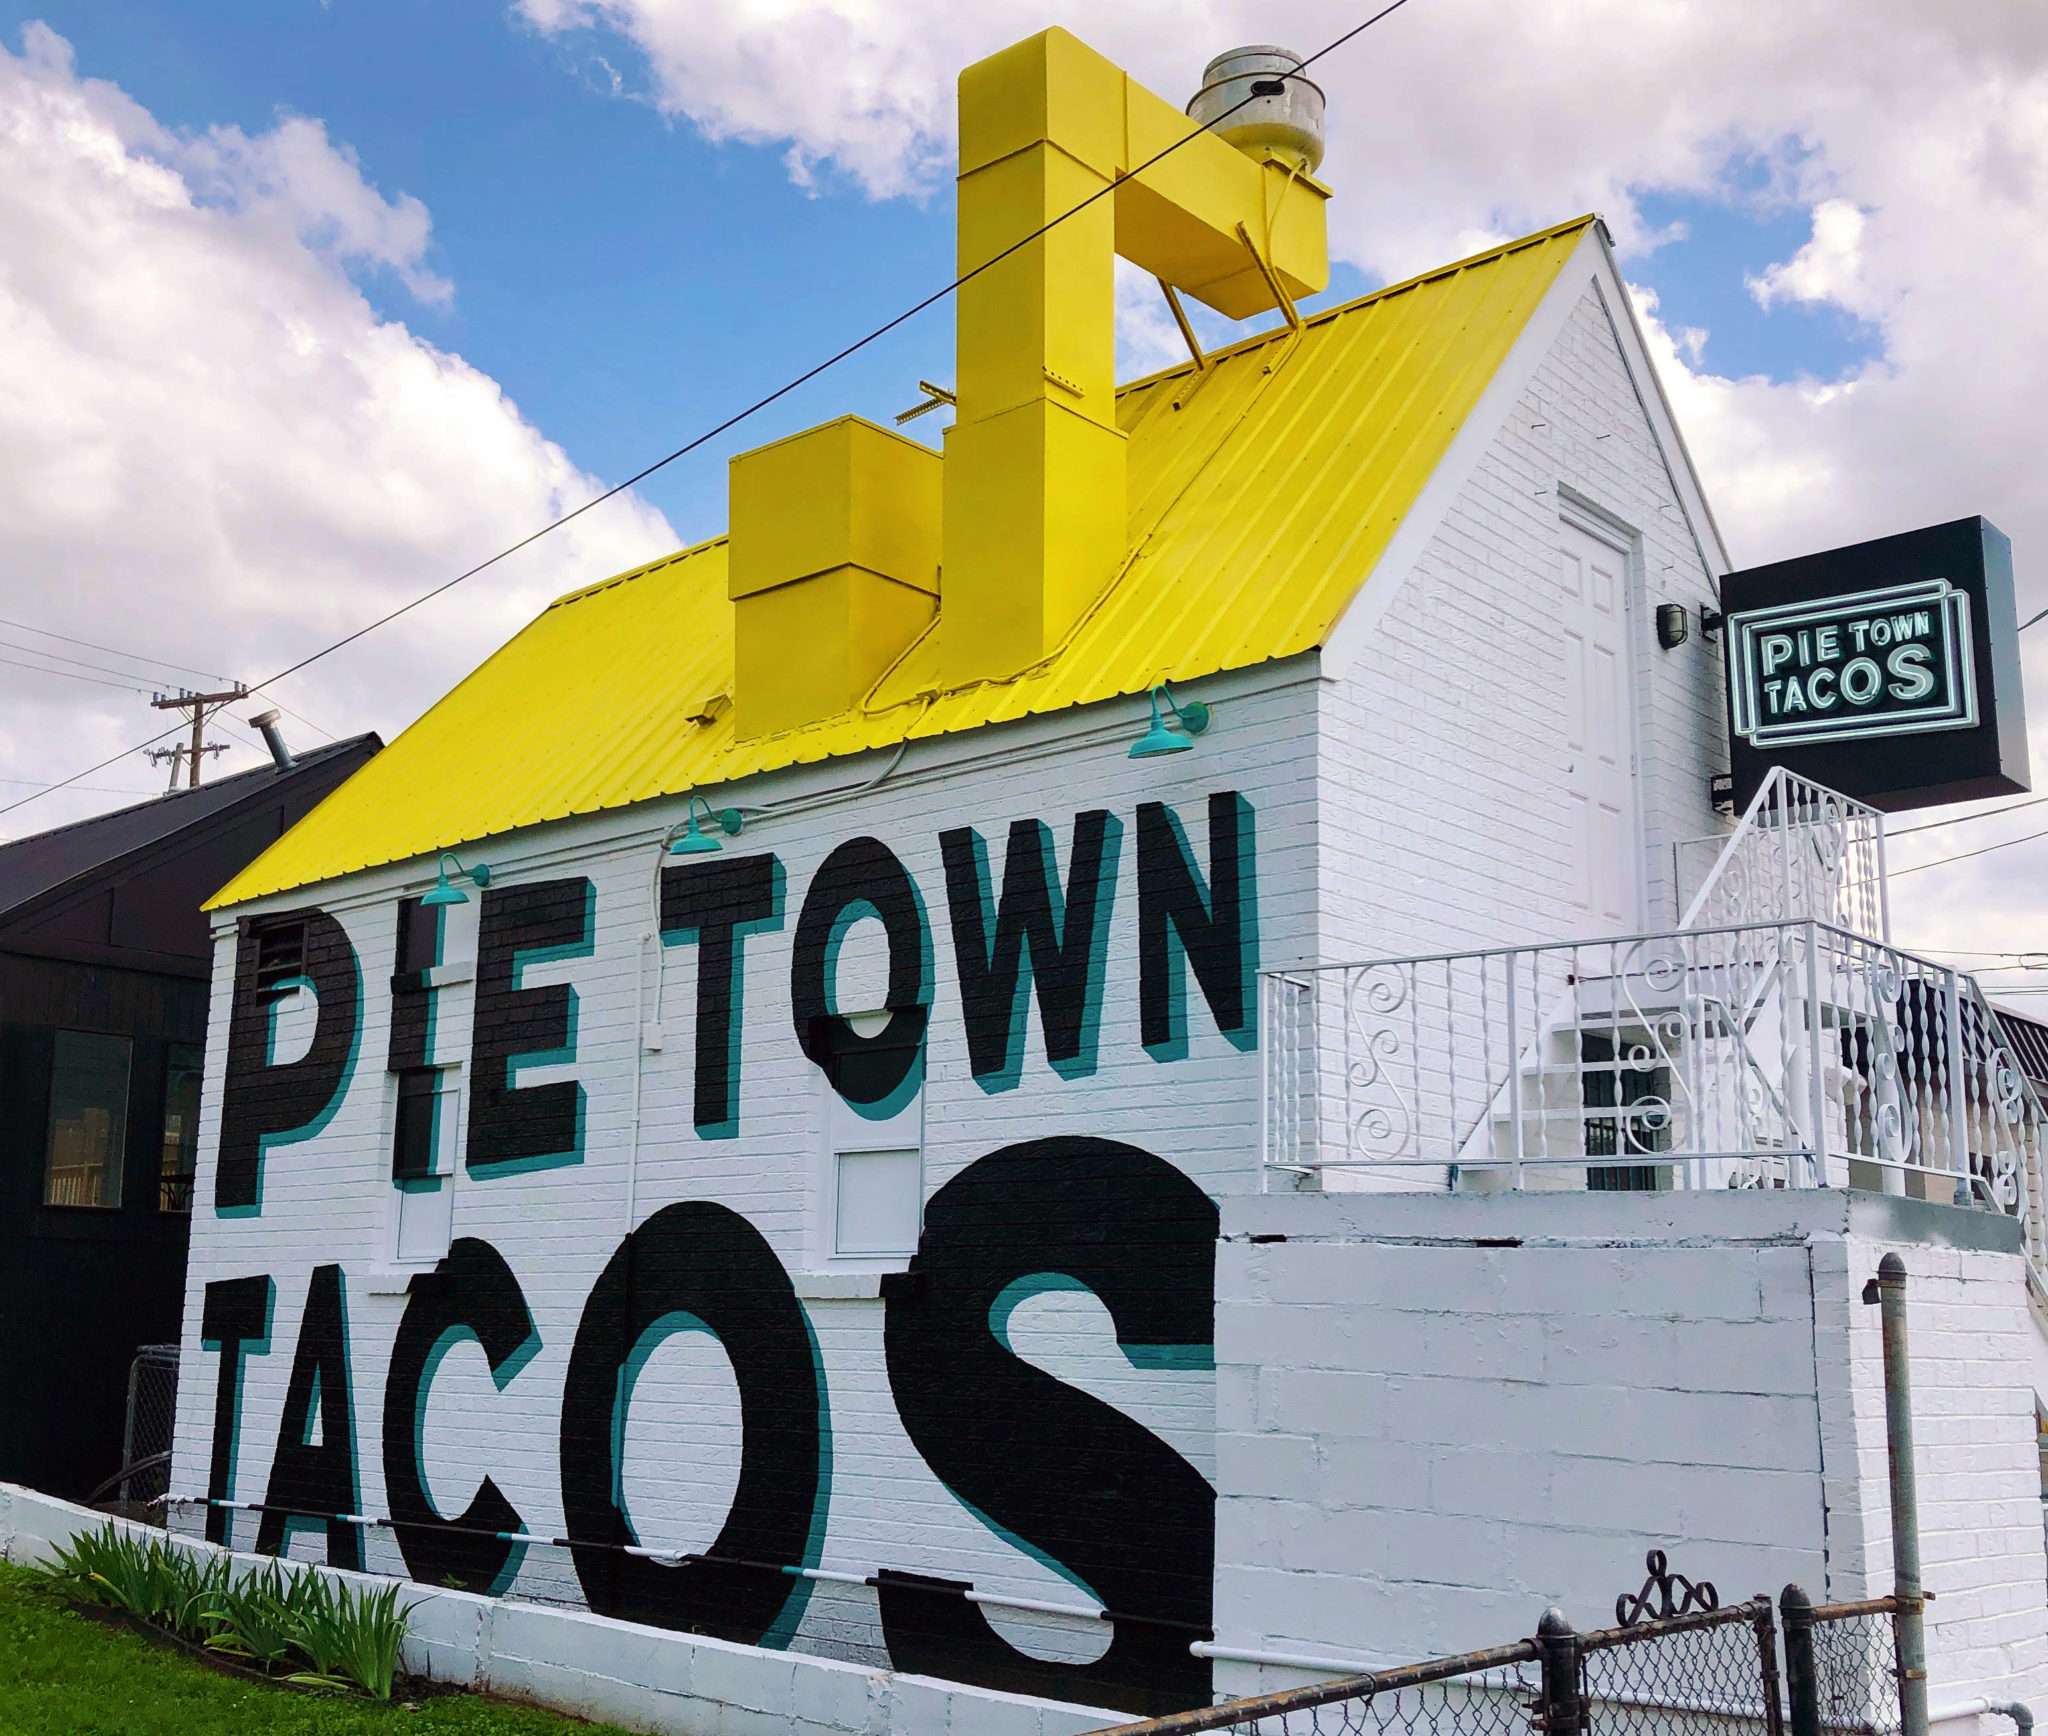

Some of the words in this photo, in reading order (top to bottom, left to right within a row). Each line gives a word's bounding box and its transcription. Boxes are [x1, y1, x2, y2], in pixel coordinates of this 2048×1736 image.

[1761, 624, 1840, 676] PIE
[1848, 611, 1930, 652] TOWN
[1764, 643, 1935, 714] TACOS
[214, 876, 597, 1219] PIE
[660, 790, 1260, 1140] TOWN
[201, 1135, 1220, 1718] TACOS
